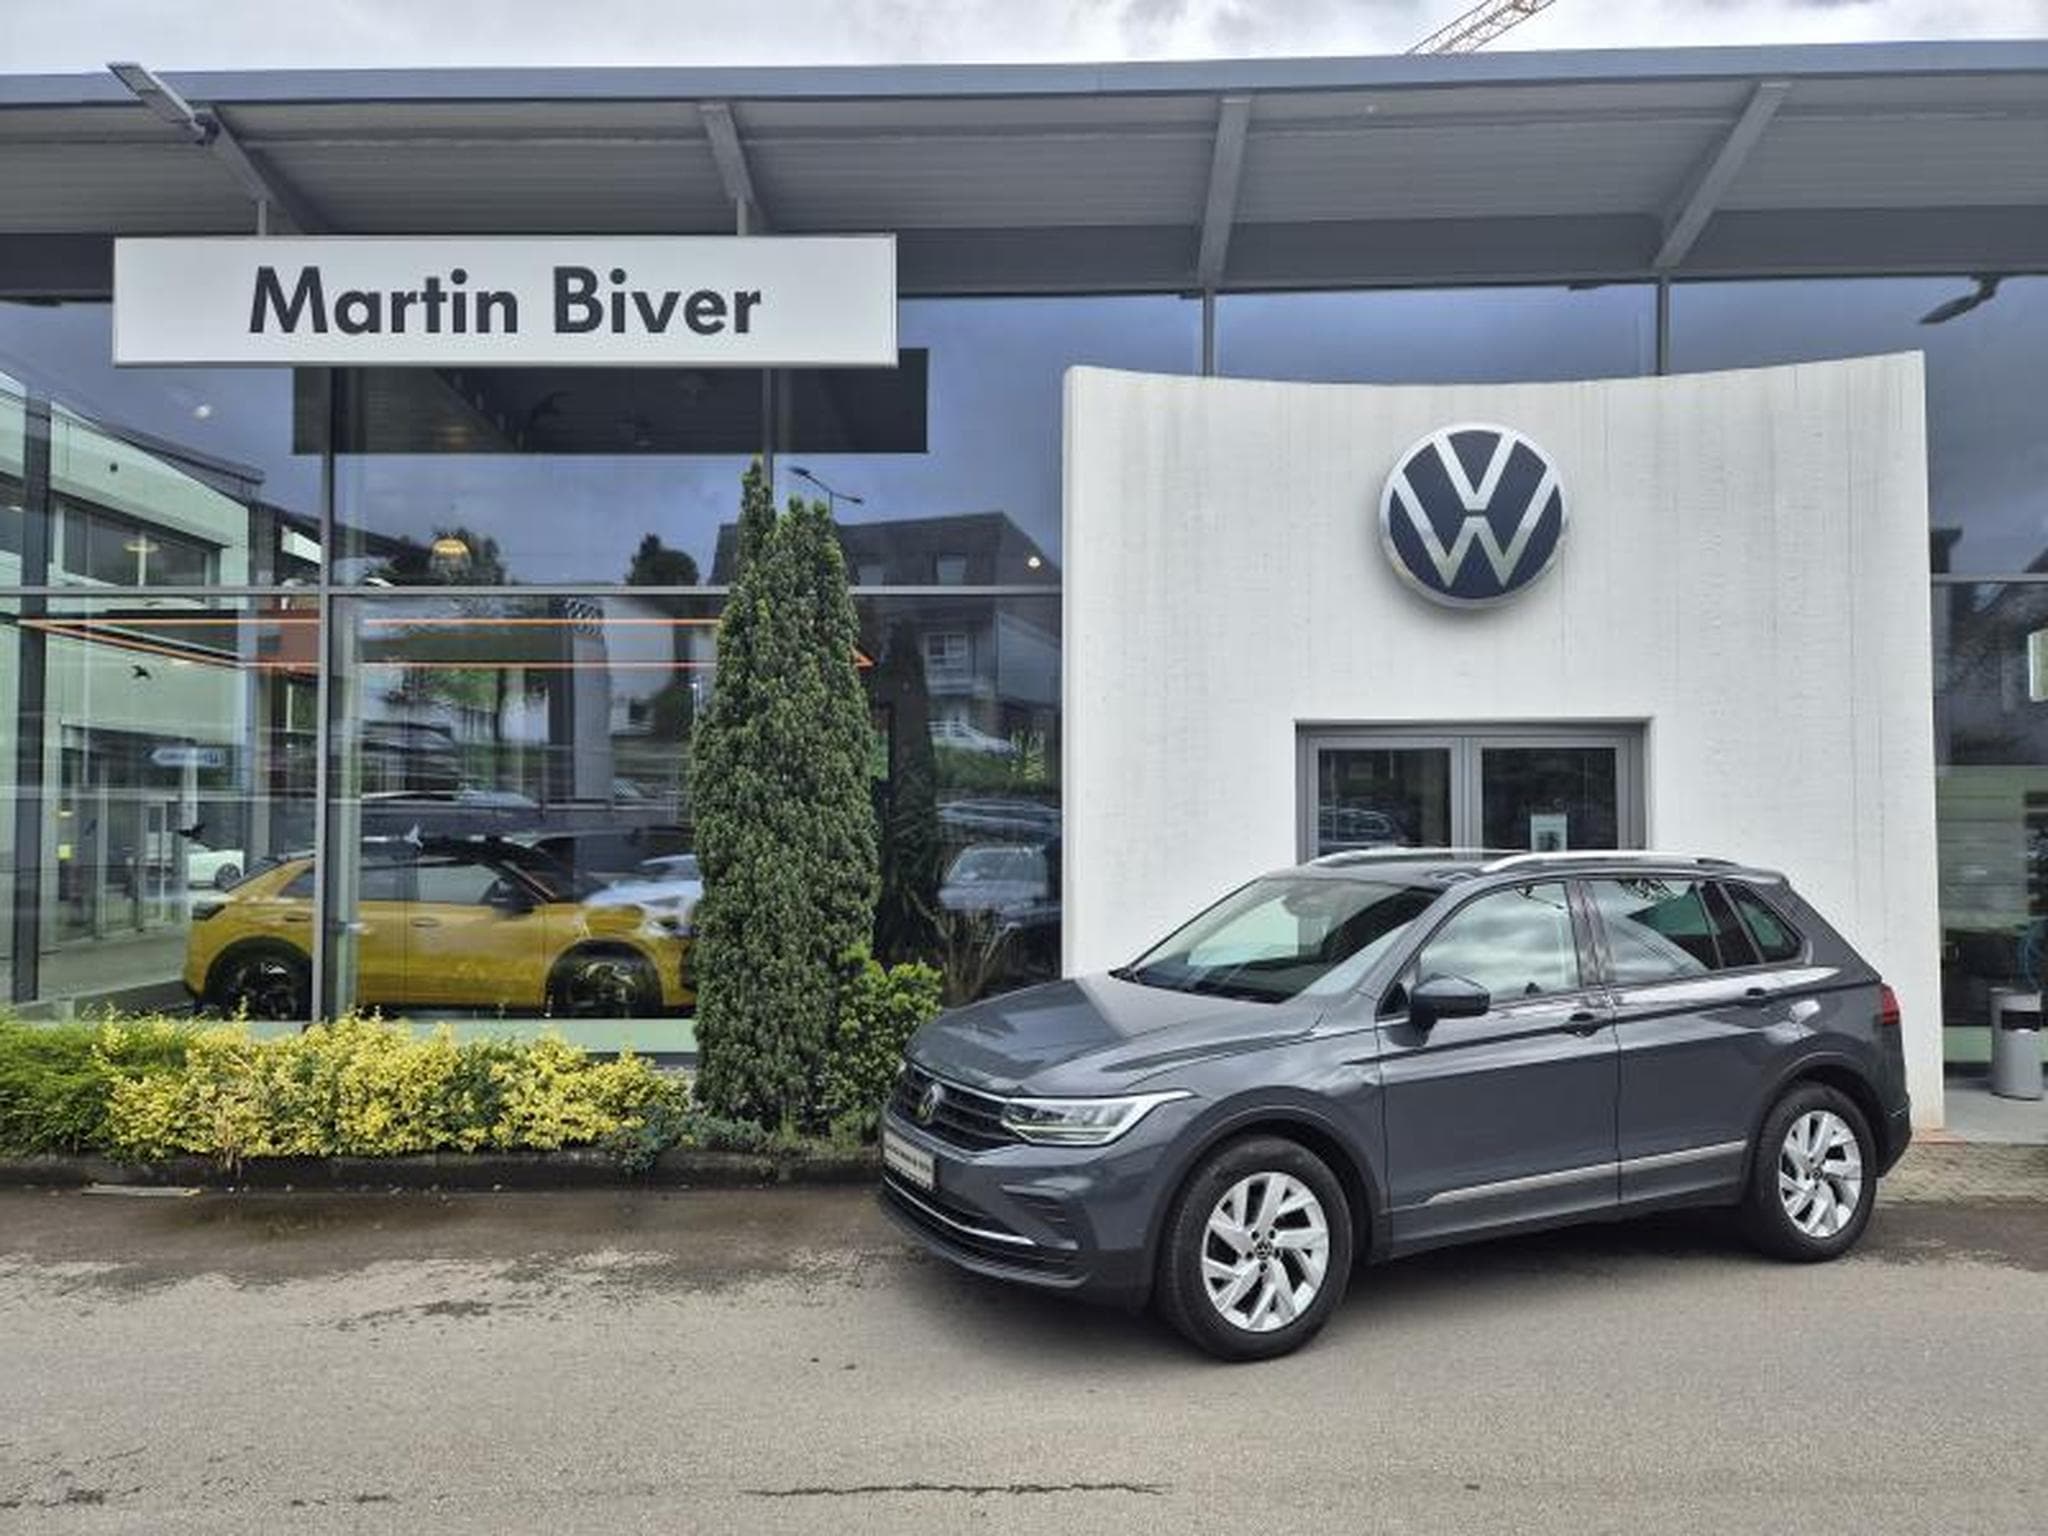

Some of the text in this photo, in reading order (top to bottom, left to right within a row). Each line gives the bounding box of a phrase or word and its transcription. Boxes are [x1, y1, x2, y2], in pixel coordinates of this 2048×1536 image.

[248, 265, 761, 335] Martin Biver
[1386, 427, 1561, 600] VW
